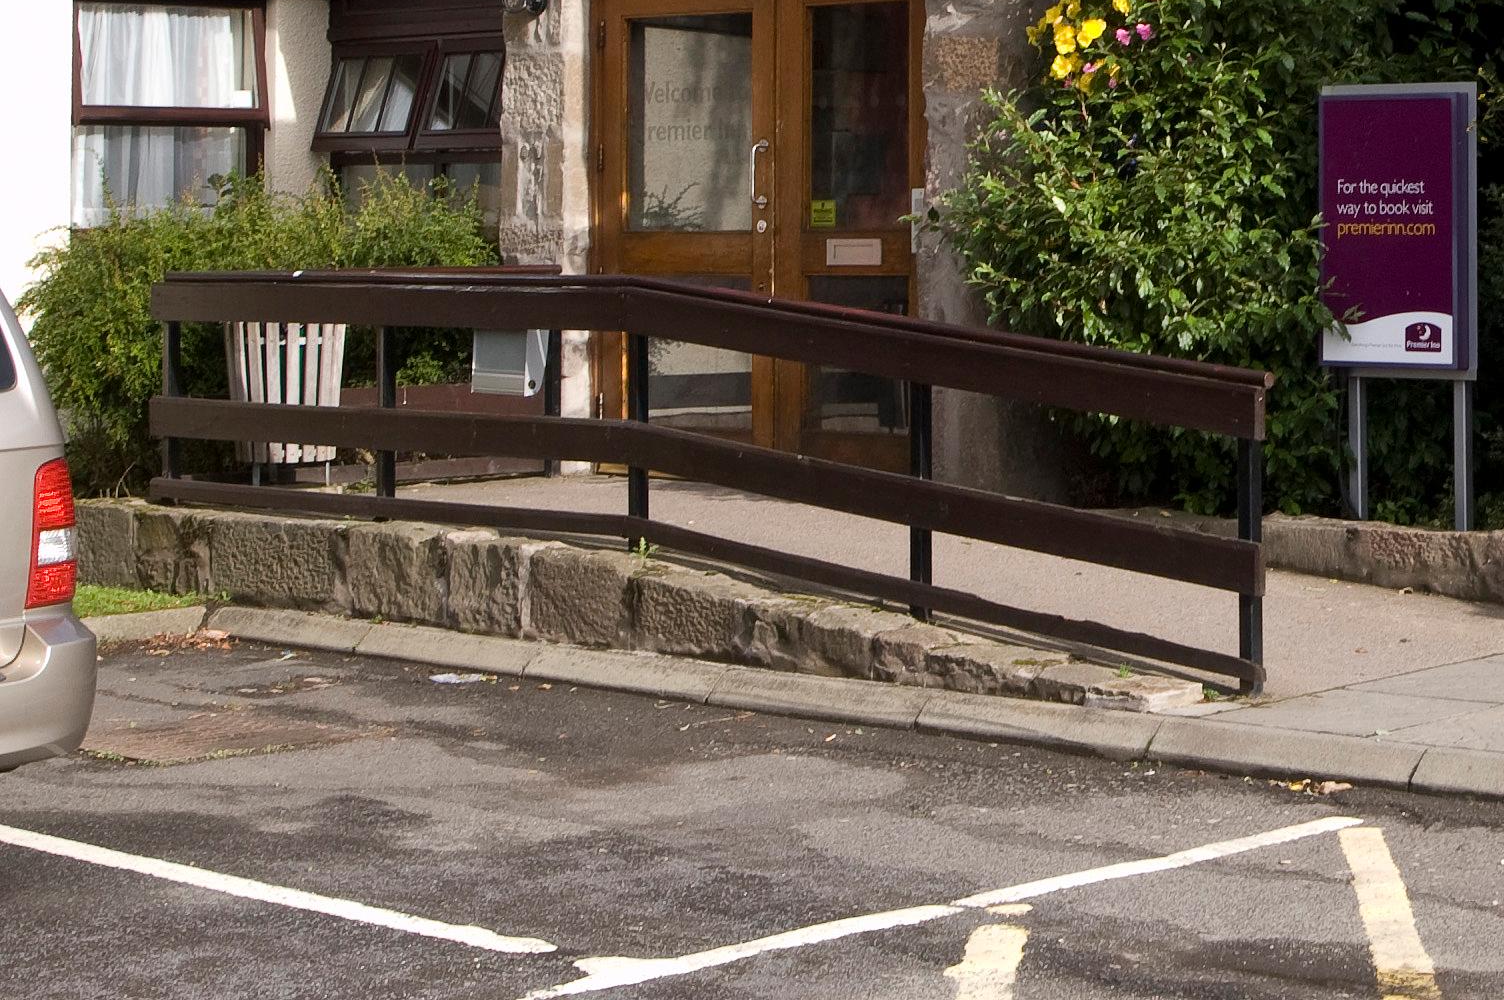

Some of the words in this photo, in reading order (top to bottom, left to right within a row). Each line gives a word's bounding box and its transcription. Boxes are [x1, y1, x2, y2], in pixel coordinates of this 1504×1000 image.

[1337, 178, 1356, 194] For
[1359, 178, 1378, 194] the
[1380, 178, 1425, 199] quickest
[1336, 203, 1361, 219] way
[1363, 201, 1377, 215] to
[1379, 199, 1410, 215] book
[1411, 199, 1434, 215] visit
[1337, 218, 1435, 240] premierinn.com
